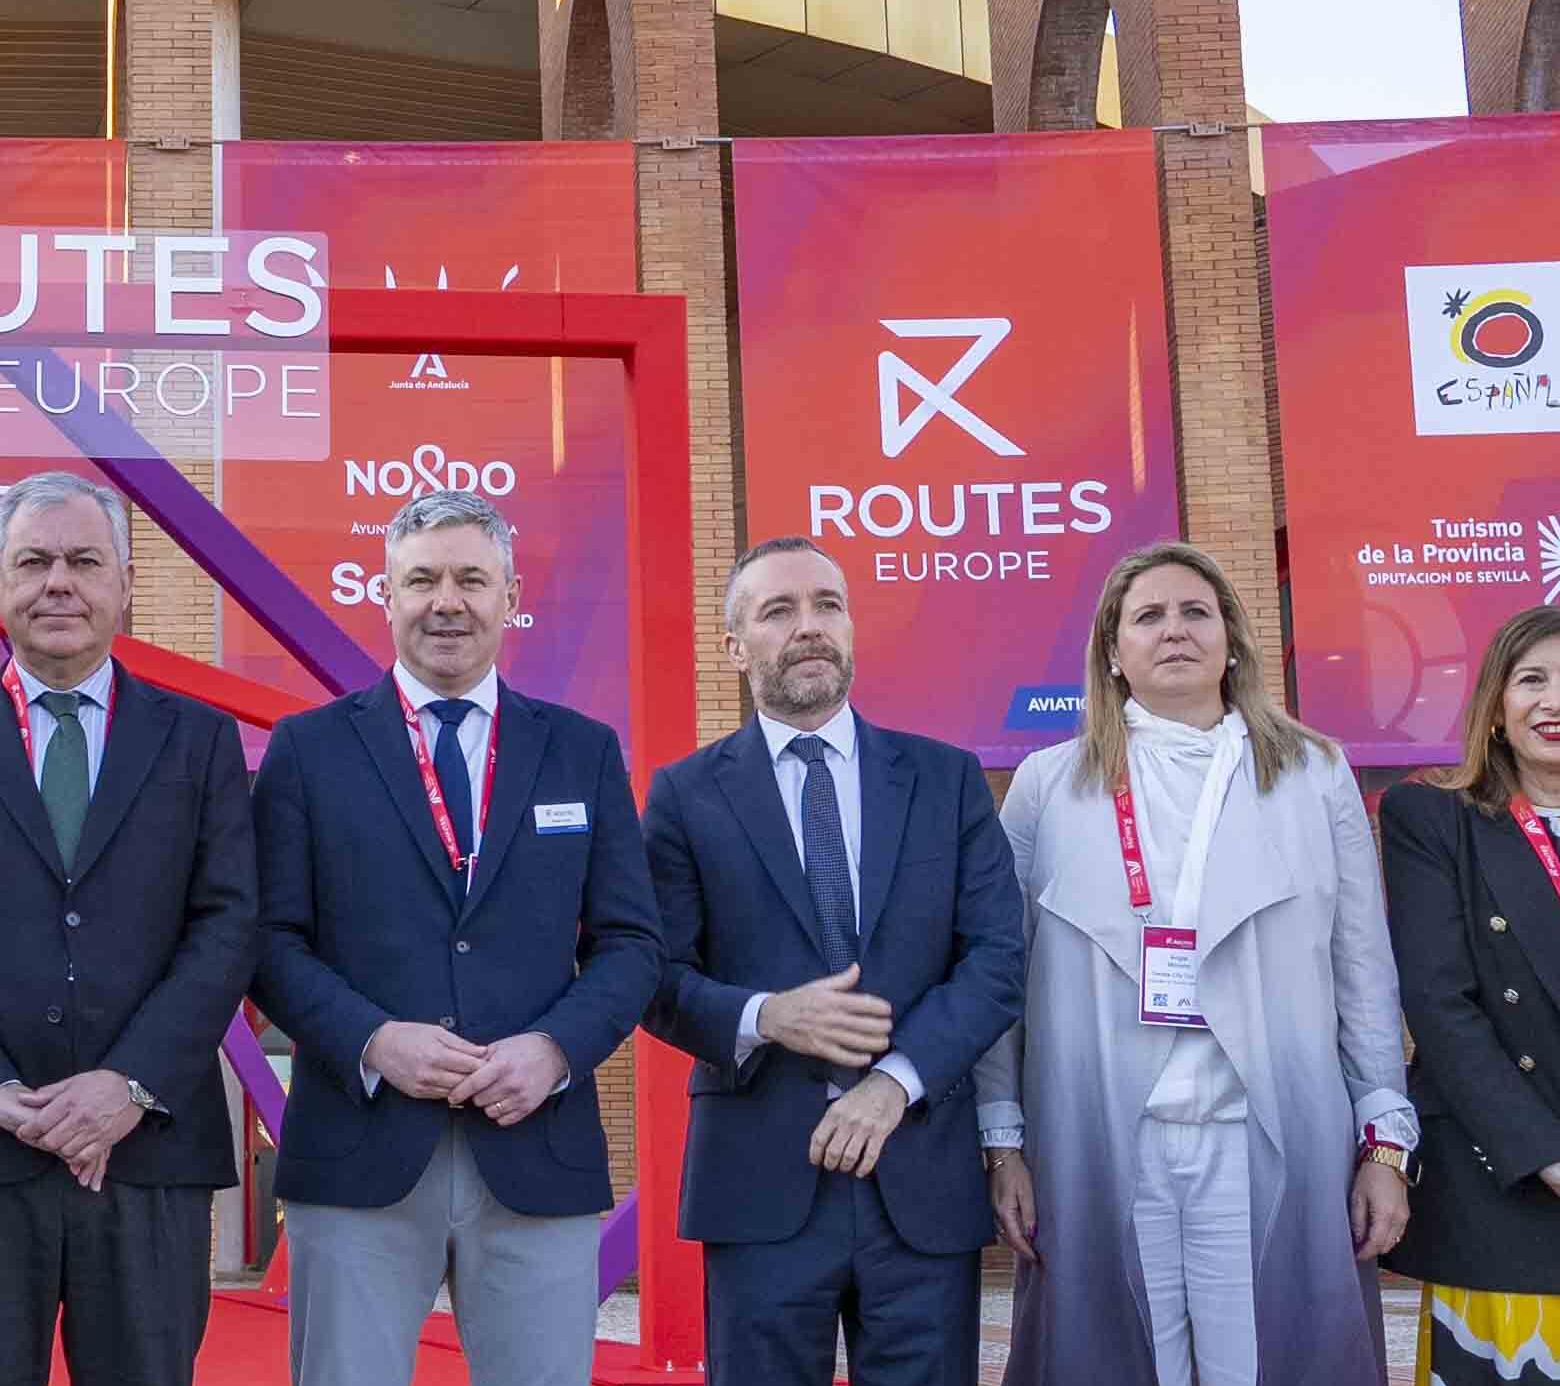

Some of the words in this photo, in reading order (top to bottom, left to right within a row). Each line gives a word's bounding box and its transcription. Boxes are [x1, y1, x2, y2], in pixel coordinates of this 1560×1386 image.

[388, 380, 415, 389] Junta
[415, 380, 426, 389] de
[808, 479, 1113, 538] ROUTES
[1431, 518, 1523, 538] Turismo
[1358, 545, 1385, 564] de
[1393, 543, 1414, 563] la
[1423, 542, 1526, 563] Provincia
[874, 550, 1051, 582] EUROPE
[1368, 571, 1453, 586] DIPUTACION
[1456, 571, 1473, 584] DE
[1477, 570, 1531, 584] SEVILLA
